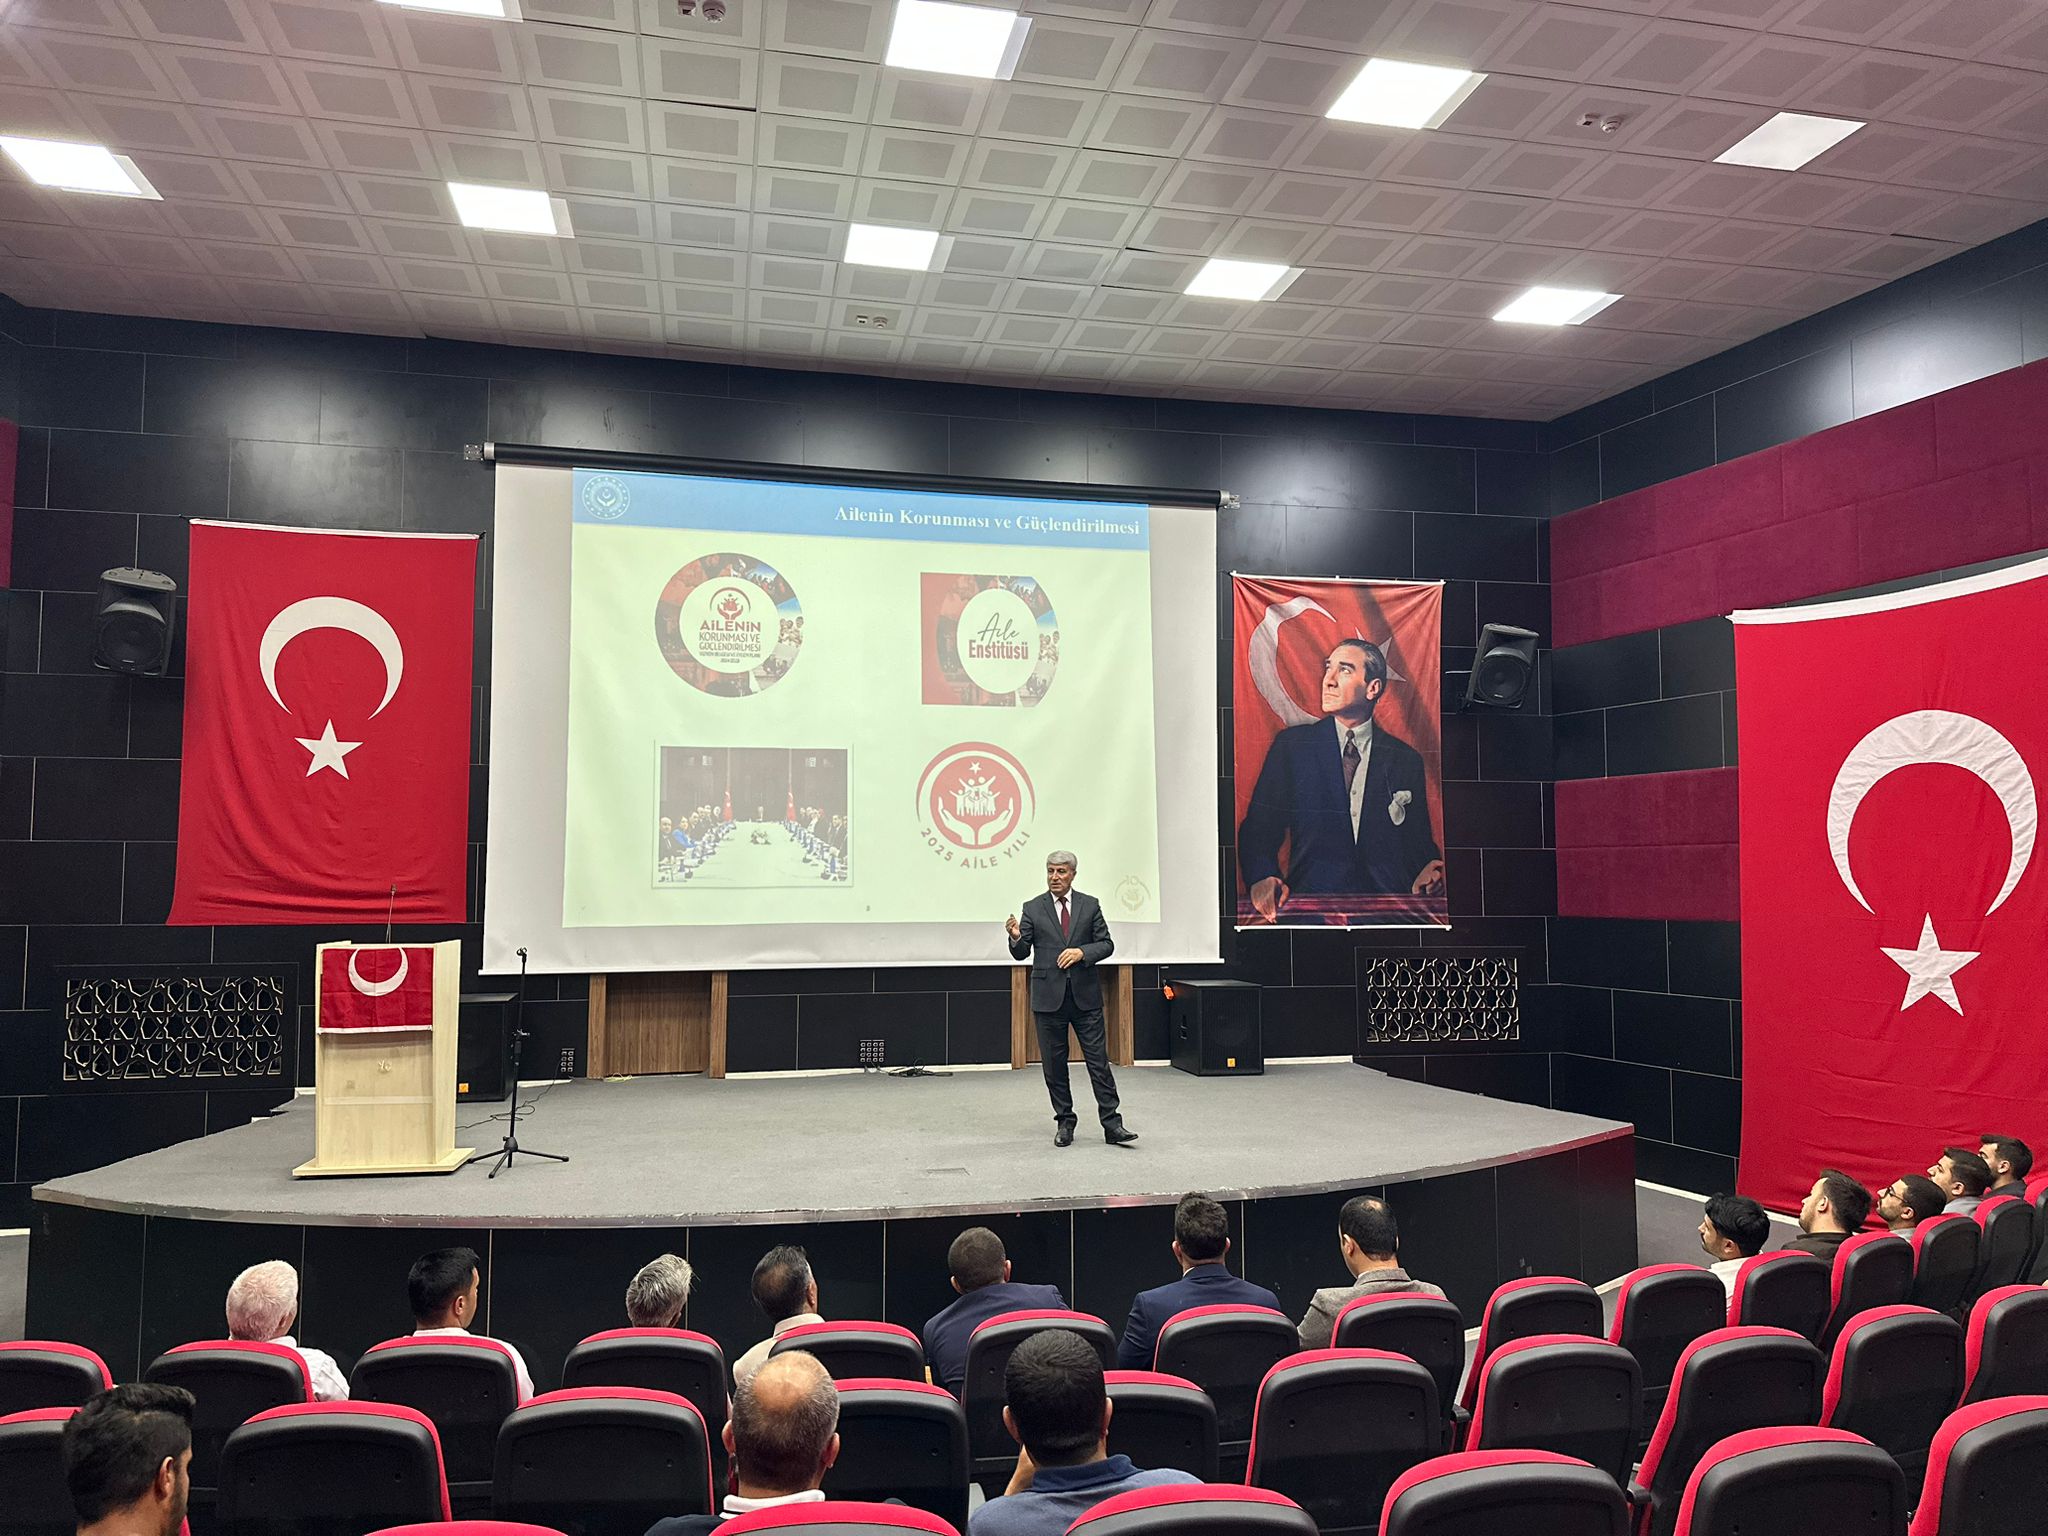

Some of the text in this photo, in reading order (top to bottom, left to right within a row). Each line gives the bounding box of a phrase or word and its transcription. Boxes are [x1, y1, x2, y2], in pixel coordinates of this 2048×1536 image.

[834, 506, 1140, 535] Ailenin Korunması ve Güçlendirilmesi
[699, 632, 761, 643] KORUNMASI VE
[977, 612, 1020, 647] Aile
[968, 639, 1029, 660] Enstitüsü
[920, 827, 954, 861] 2025
[1003, 831, 1031, 858] YILI
